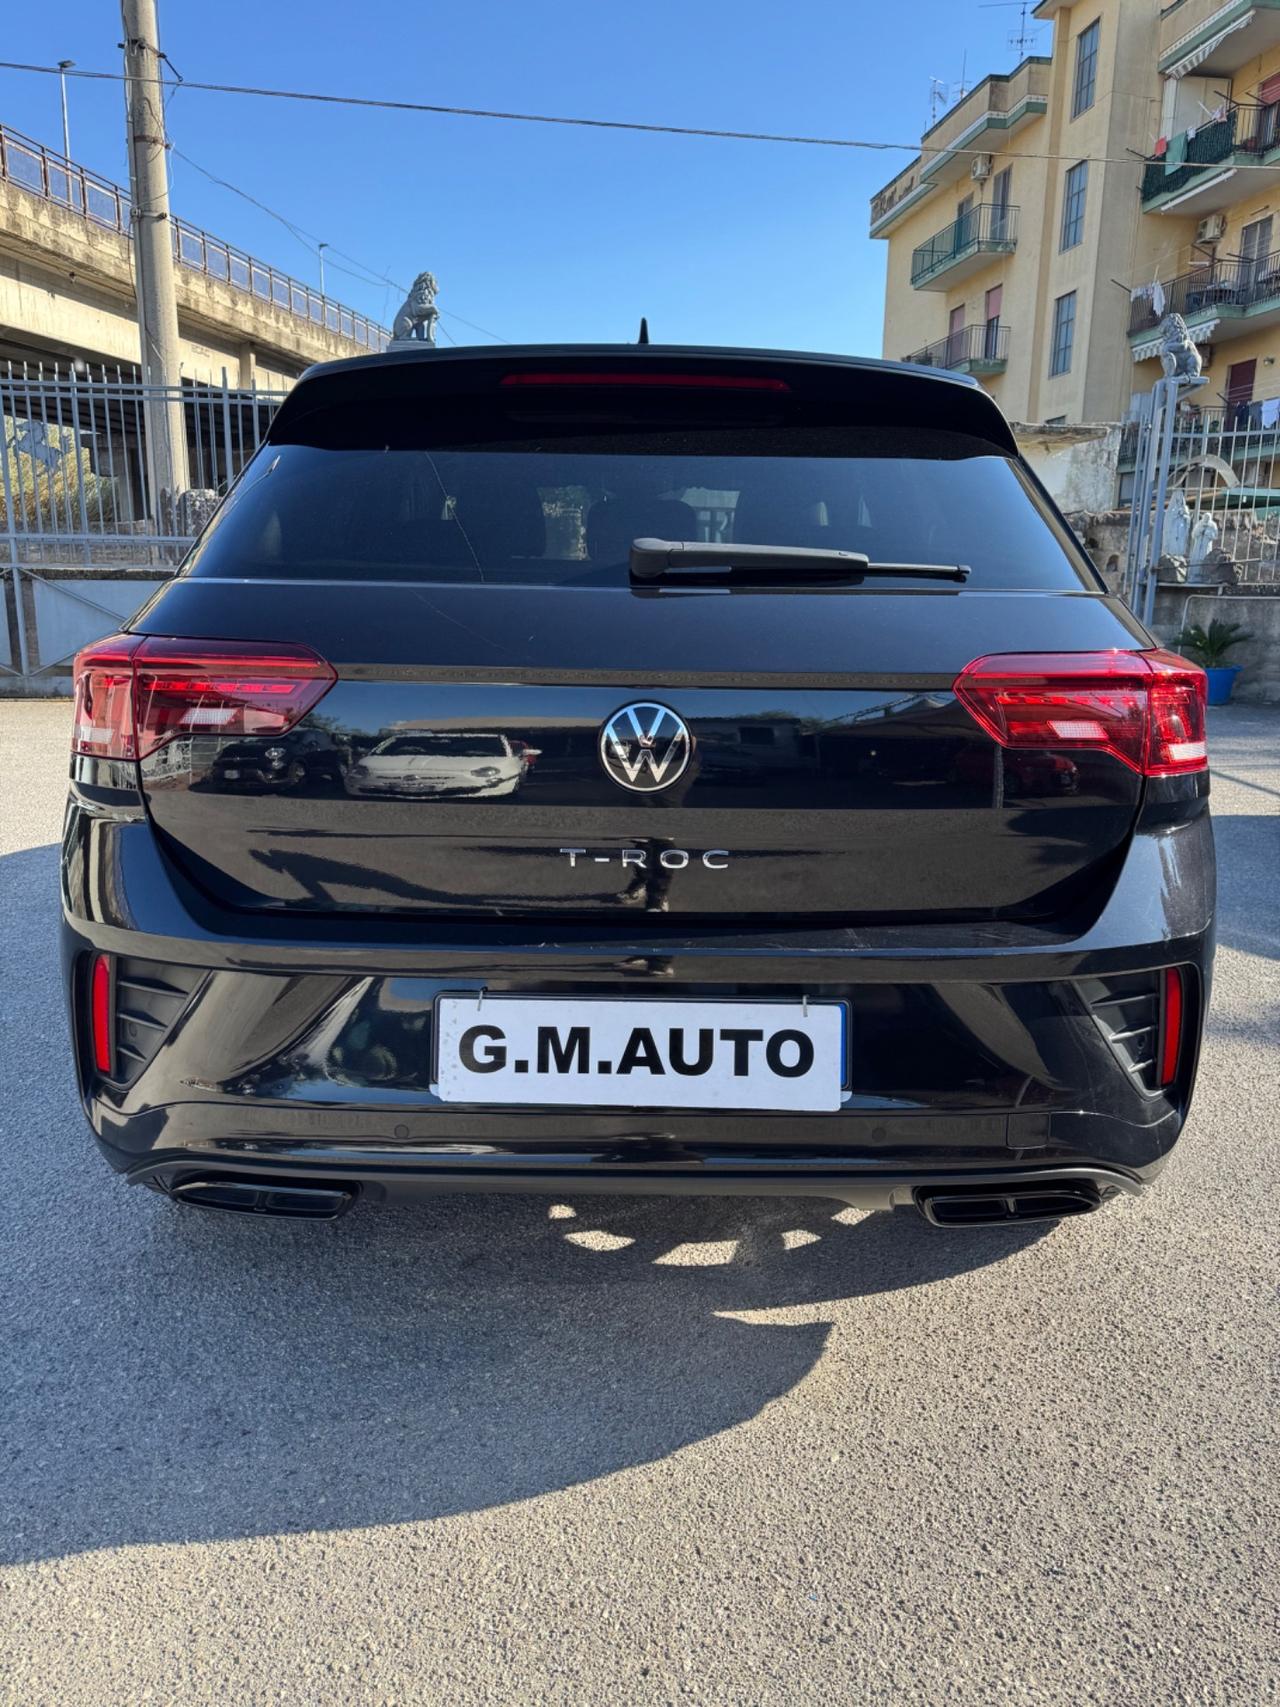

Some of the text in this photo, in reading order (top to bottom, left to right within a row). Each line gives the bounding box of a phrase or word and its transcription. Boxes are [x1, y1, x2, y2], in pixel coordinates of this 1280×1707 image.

[604, 705, 687, 786] VW
[559, 848, 730, 870] T-ROC
[457, 1023, 816, 1079] G.M.AUTO
